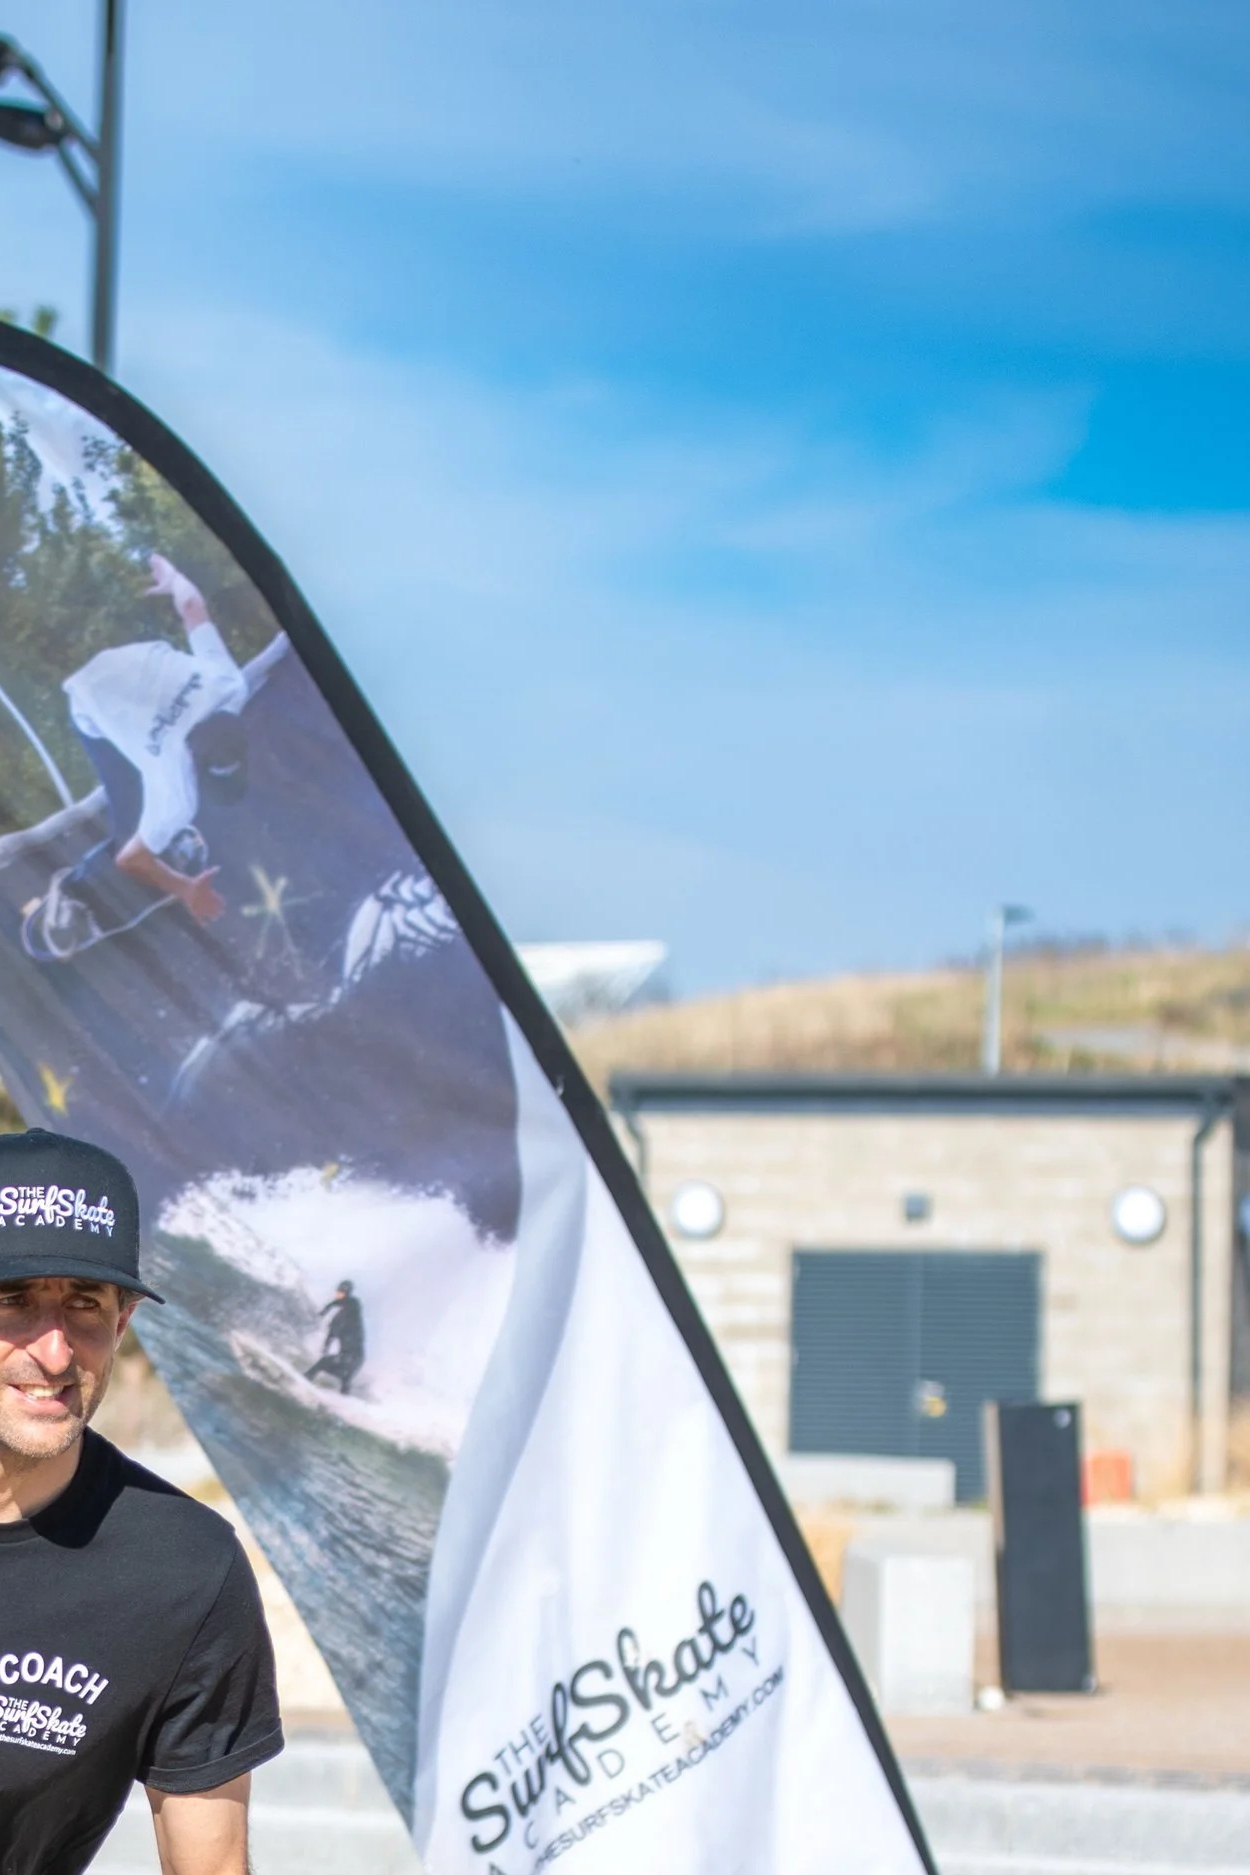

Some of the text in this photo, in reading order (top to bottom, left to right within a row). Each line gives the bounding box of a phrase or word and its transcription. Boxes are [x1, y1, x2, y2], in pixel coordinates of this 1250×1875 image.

[18, 1186, 45, 1199] THE
[8, 1697, 29, 1710] THE
[493, 1713, 551, 1777] THE
